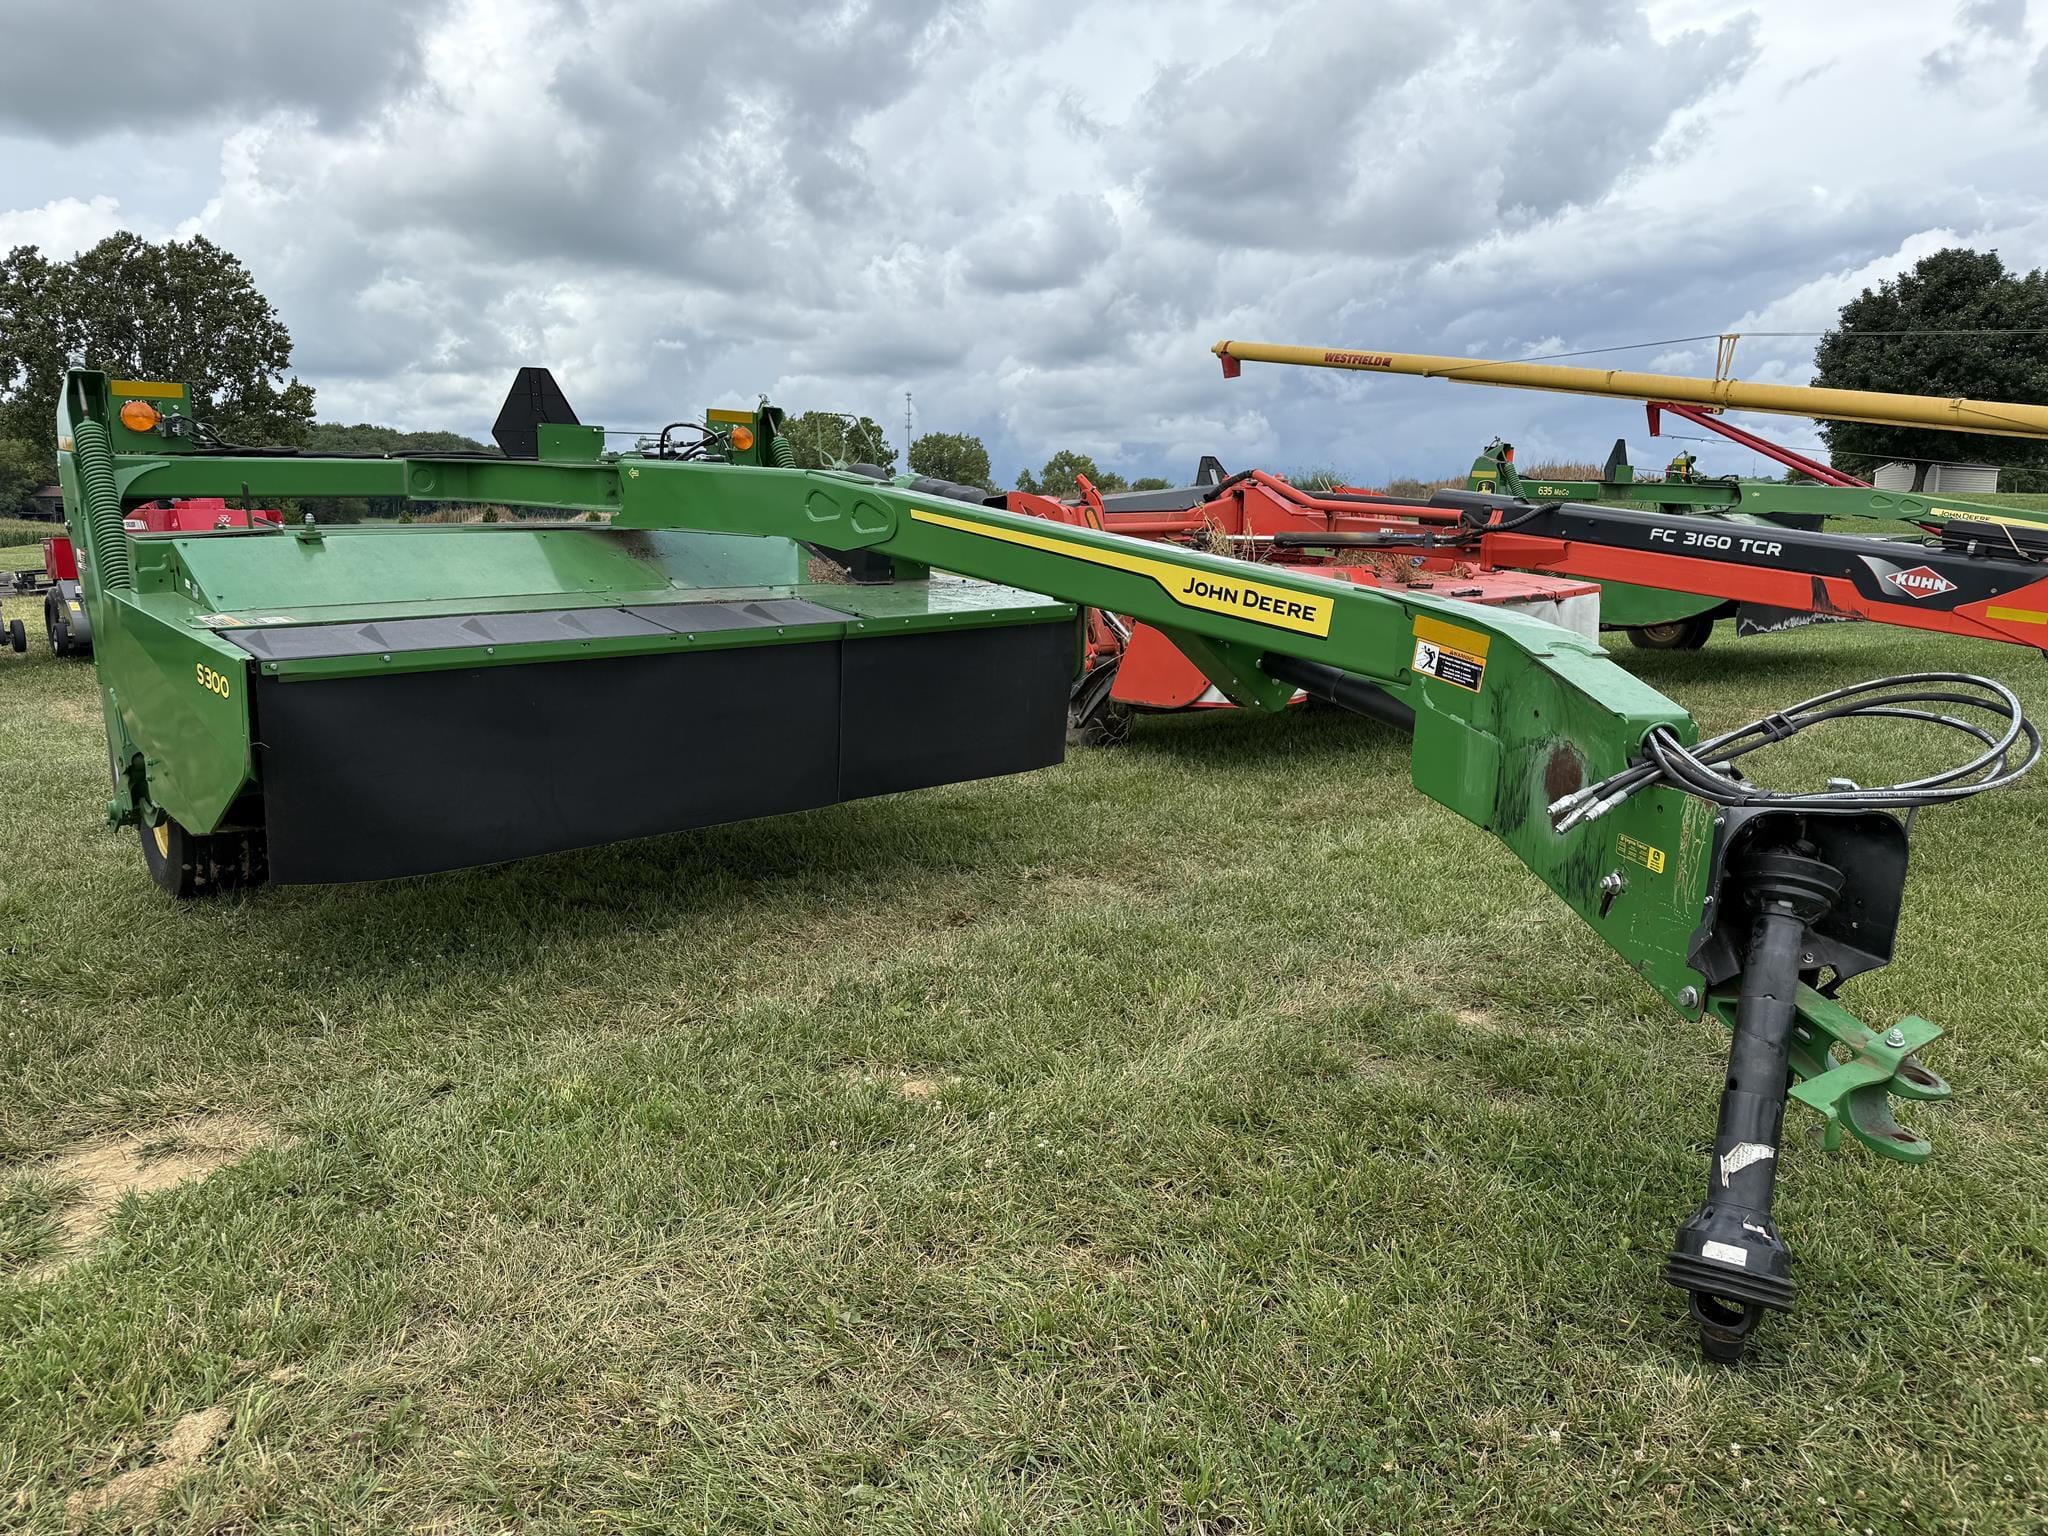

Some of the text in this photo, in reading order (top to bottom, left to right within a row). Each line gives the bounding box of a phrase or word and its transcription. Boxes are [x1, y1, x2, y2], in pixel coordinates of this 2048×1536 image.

[1324, 352, 1383, 366] WESTFIELD
[1537, 486, 1554, 496] 635
[1941, 510, 1962, 520] JOHN
[1649, 527, 1783, 557] FC 3160 TCR
[1895, 572, 1948, 591] KUHN
[1182, 577, 1317, 622] JOHN DEERE
[196, 662, 230, 699] S300
